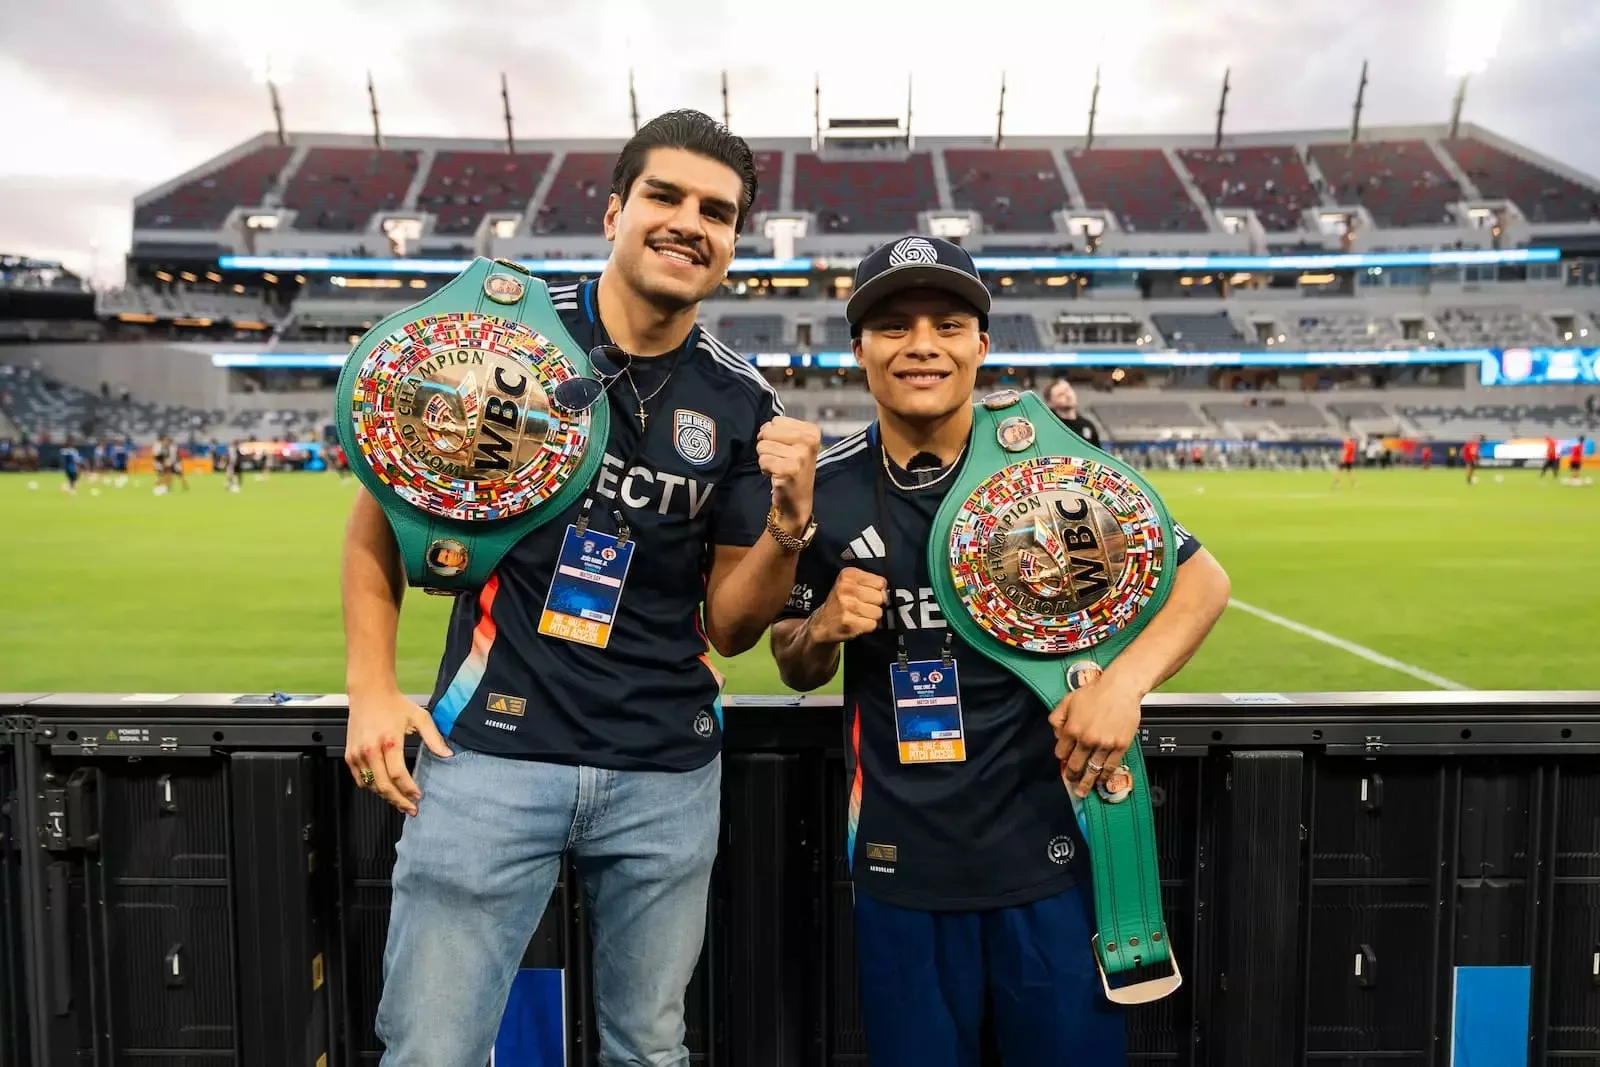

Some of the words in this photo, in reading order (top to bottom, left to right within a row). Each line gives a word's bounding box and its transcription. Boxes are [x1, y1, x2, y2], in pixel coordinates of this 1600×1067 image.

[400, 350, 485, 416] CHAMPION
[474, 366, 528, 470] WBC
[678, 414, 693, 425] SAN
[693, 416, 712, 432] DIEGO
[402, 424, 460, 477] WORLD
[990, 495, 1042, 584] CHAMPION
[1055, 498, 1109, 598] WBC
[1005, 584, 1070, 615] WORLD
[484, 719, 517, 732] AEROREADY
[1053, 842, 1069, 858] SD
